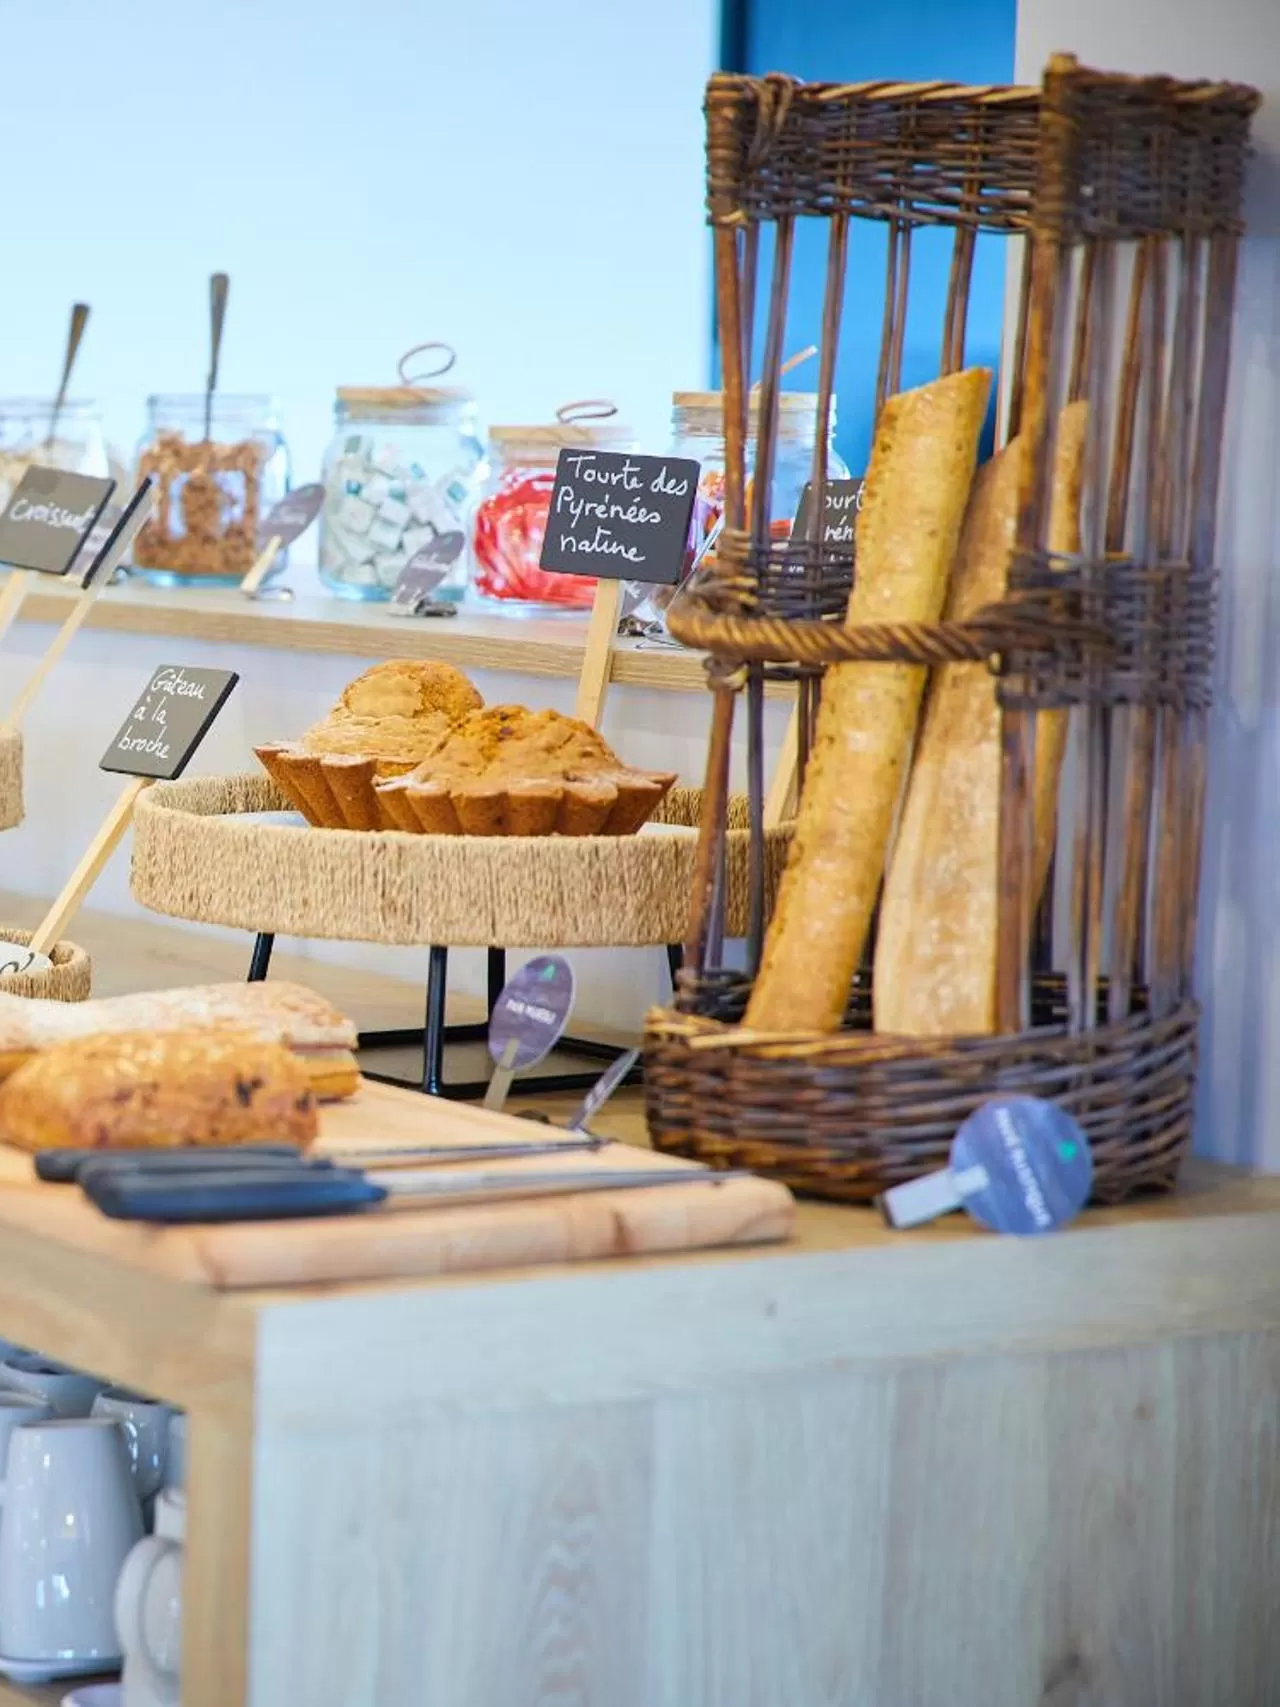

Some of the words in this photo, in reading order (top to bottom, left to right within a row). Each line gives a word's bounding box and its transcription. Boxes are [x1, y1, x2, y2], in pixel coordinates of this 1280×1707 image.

[566, 455, 644, 490] Tourte
[650, 466, 689, 496] des
[556, 486, 662, 529] Pyrénées
[560, 526, 646, 562] nature
[151, 668, 206, 700] Gâteau
[133, 695, 152, 721] à
[151, 695, 167, 725] la
[118, 725, 170, 759] broche
